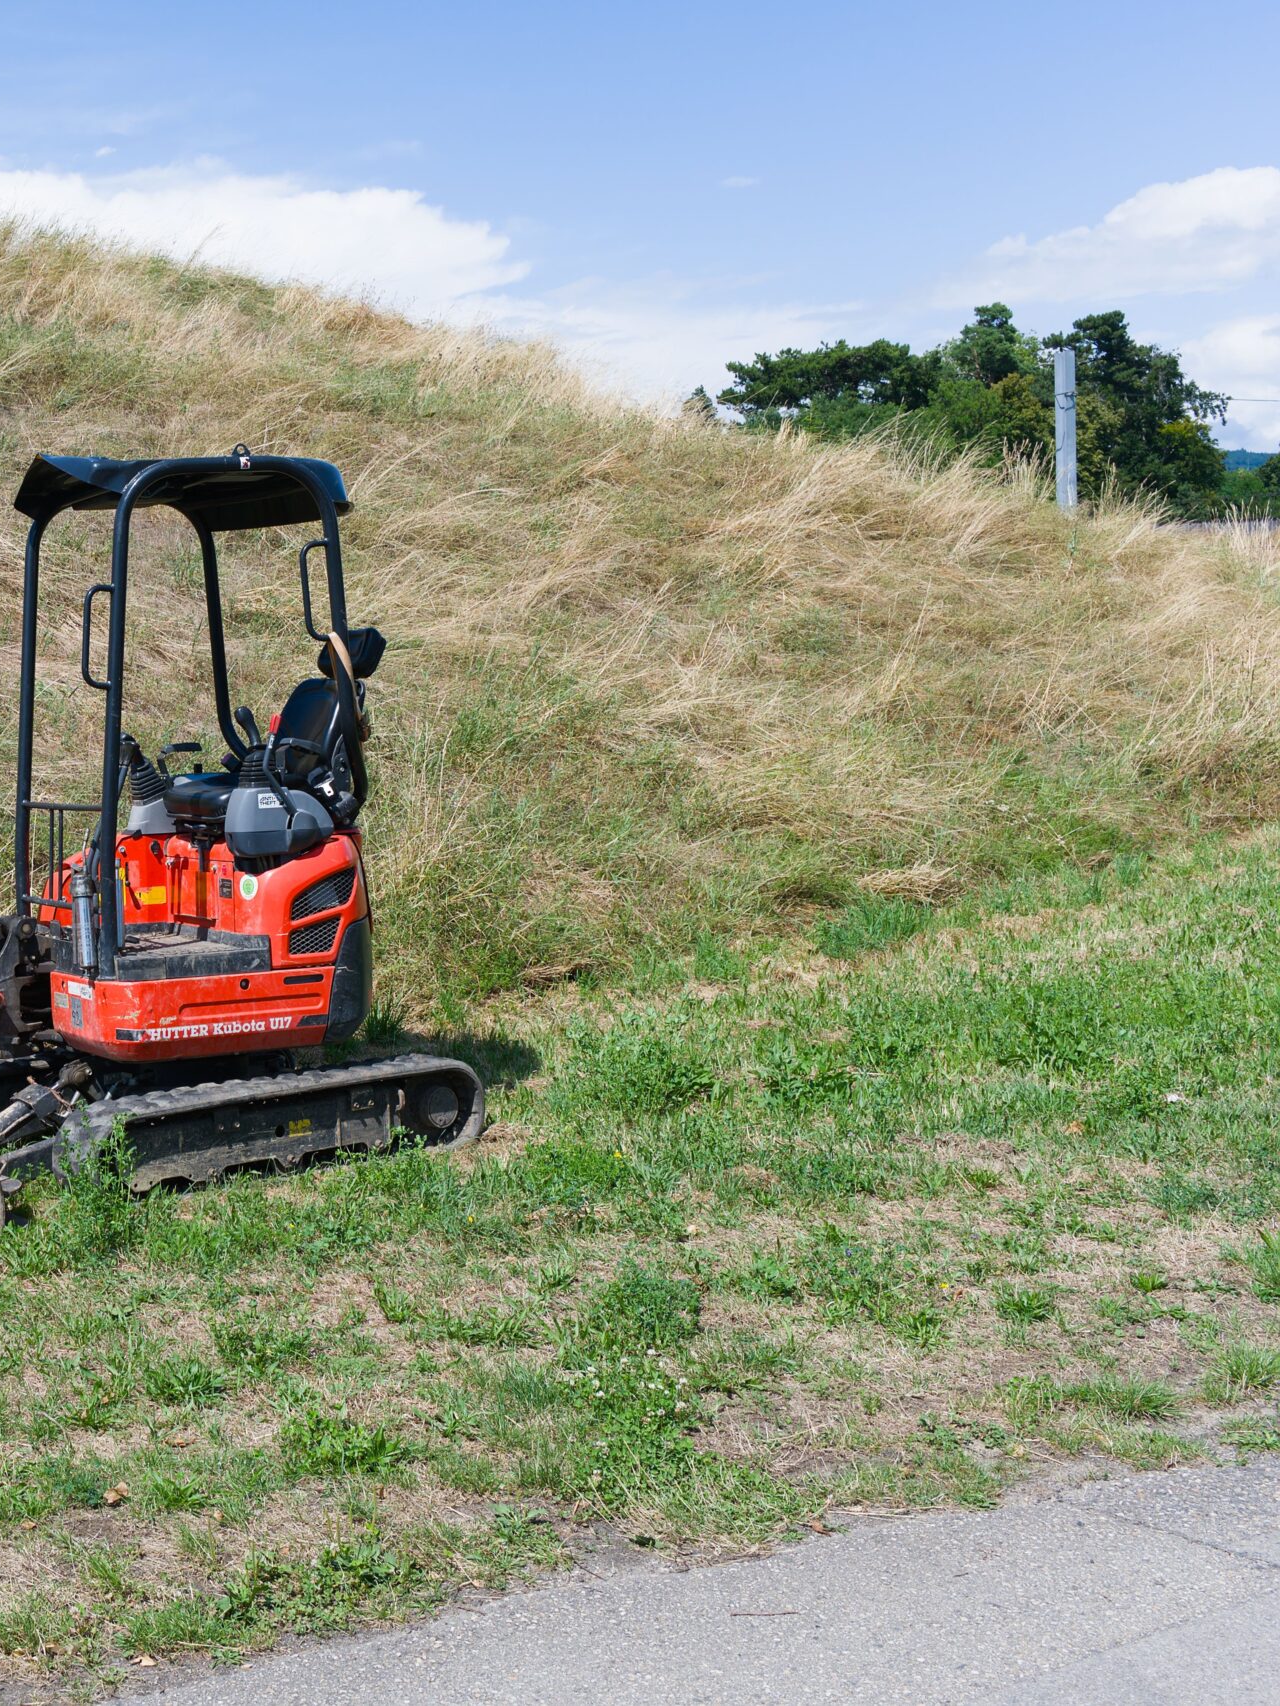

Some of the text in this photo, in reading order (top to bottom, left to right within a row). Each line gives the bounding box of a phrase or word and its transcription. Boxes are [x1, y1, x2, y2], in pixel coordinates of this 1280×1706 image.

[150, 1016, 293, 1042] HUTTER Kubota U17
